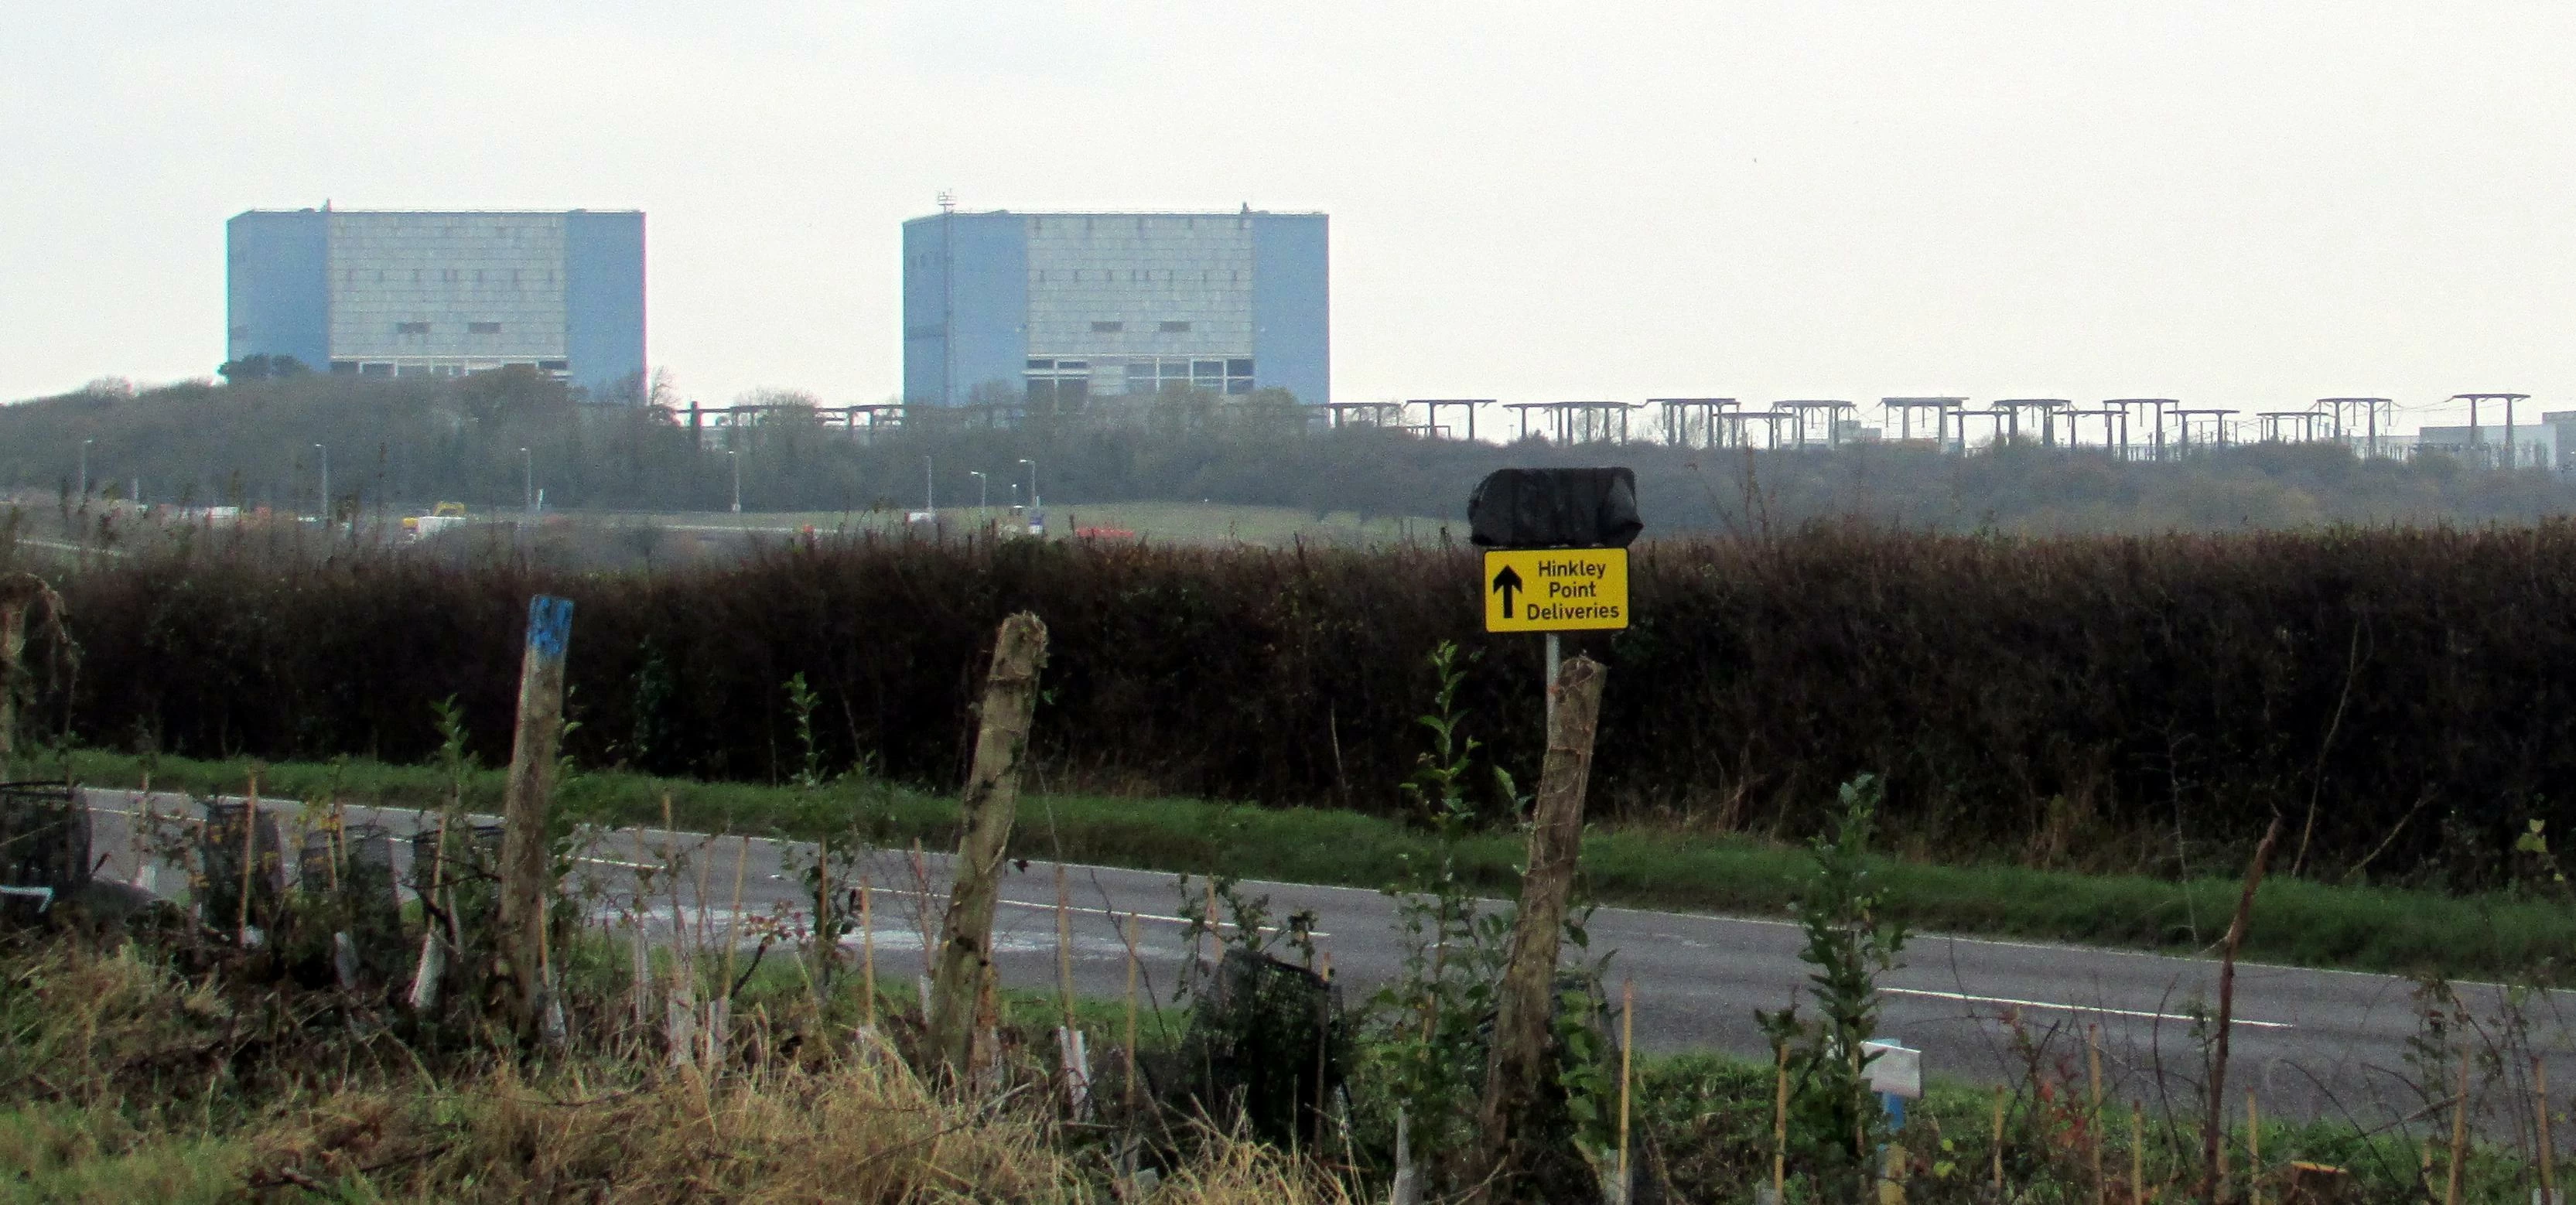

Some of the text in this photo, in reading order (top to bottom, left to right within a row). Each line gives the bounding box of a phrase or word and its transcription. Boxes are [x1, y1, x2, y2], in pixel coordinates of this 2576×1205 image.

[1538, 560, 1606, 579] Hinkley
[1549, 582, 1597, 598] Point
[1527, 603, 1620, 620] Deliveries
